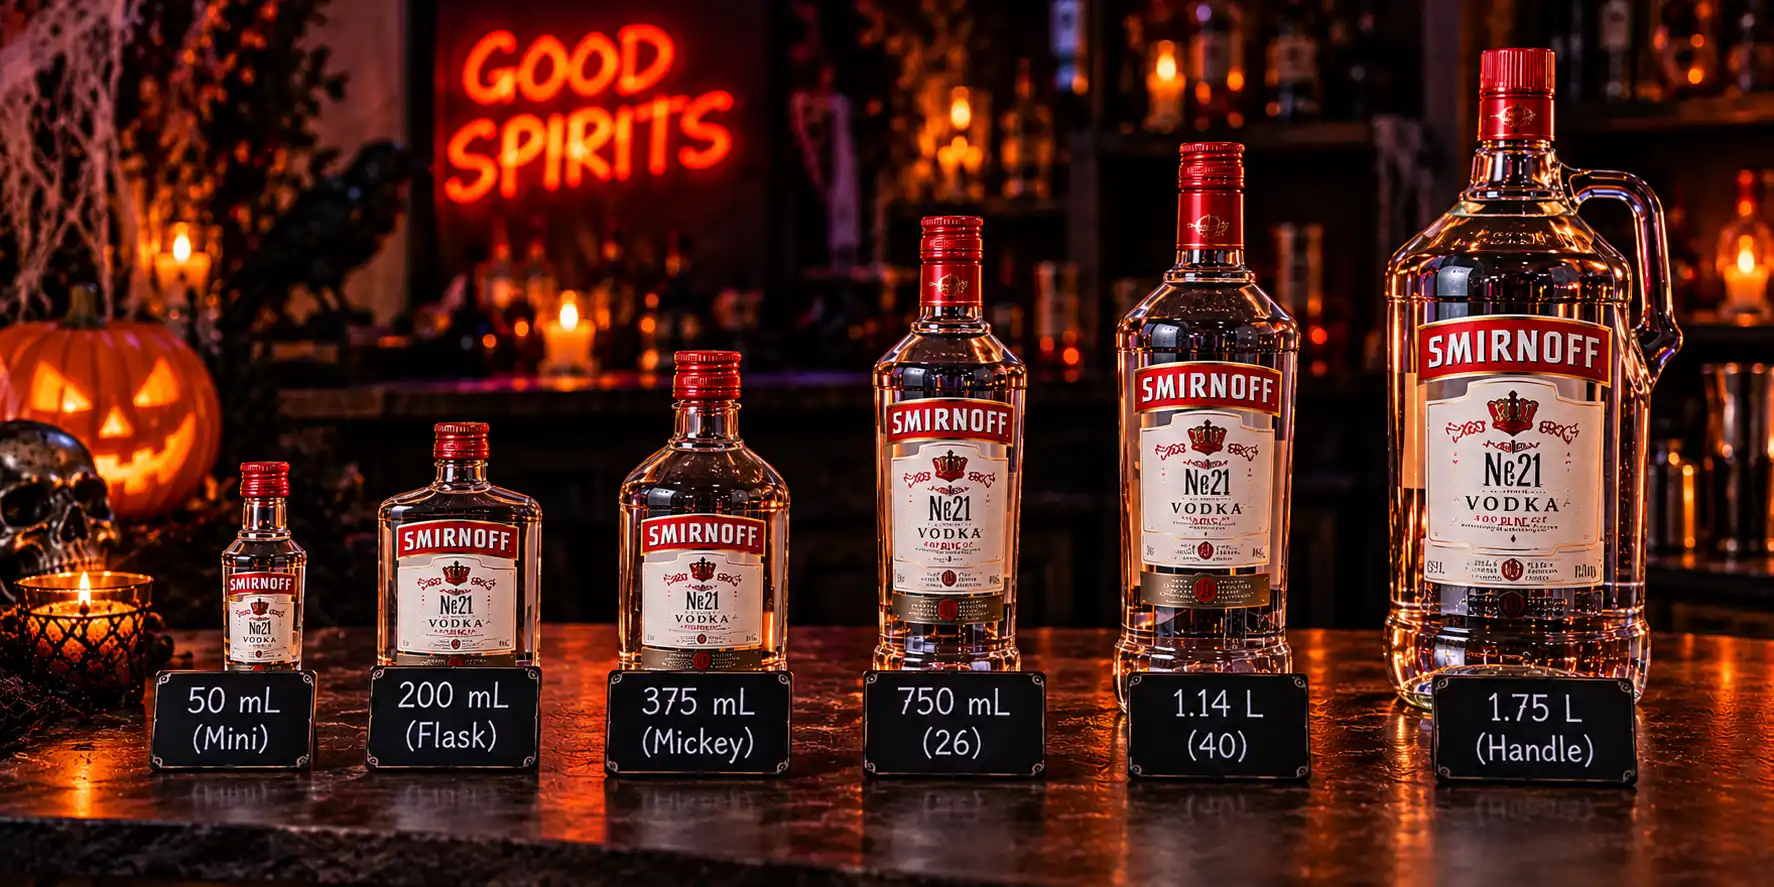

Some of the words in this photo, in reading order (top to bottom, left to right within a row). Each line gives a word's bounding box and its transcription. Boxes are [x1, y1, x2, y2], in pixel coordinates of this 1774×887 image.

[462, 23, 675, 105] GOOD
[445, 90, 734, 204] SPIRITS
[1428, 329, 1600, 369] SMIRNOFF
[1142, 372, 1273, 403] SMIRNOFF
[892, 407, 1008, 435] SMIRNOFF
[1171, 502, 1243, 515] VODKA
[1465, 495, 1559, 512] VODKA
[404, 527, 511, 551] SMIRNOFF
[649, 522, 758, 547] SMIRNOFF
[917, 527, 982, 539] VODKA
[229, 577, 292, 591] SMIRNOFF
[429, 619, 483, 628] VODKA
[675, 614, 729, 624] VODKA
[187, 686, 226, 714] 50
[239, 686, 281, 714] mL
[397, 681, 454, 709] 200
[468, 681, 509, 709] mL
[642, 686, 697, 716] 375
[713, 687, 756, 716] mL
[897, 686, 954, 716] 750
[968, 687, 1011, 716] mL
[1173, 688, 1231, 718] 1.14
[1246, 689, 1264, 718] L
[1488, 692, 1549, 722] 1.75
[1565, 694, 1583, 723] L
[193, 723, 268, 754] (Mini)
[406, 719, 497, 753] (Flask)
[642, 725, 754, 764] (Mickey)
[923, 726, 982, 760] (26)
[1188, 729, 1247, 763] (40)
[1476, 731, 1594, 768] (Handle)
